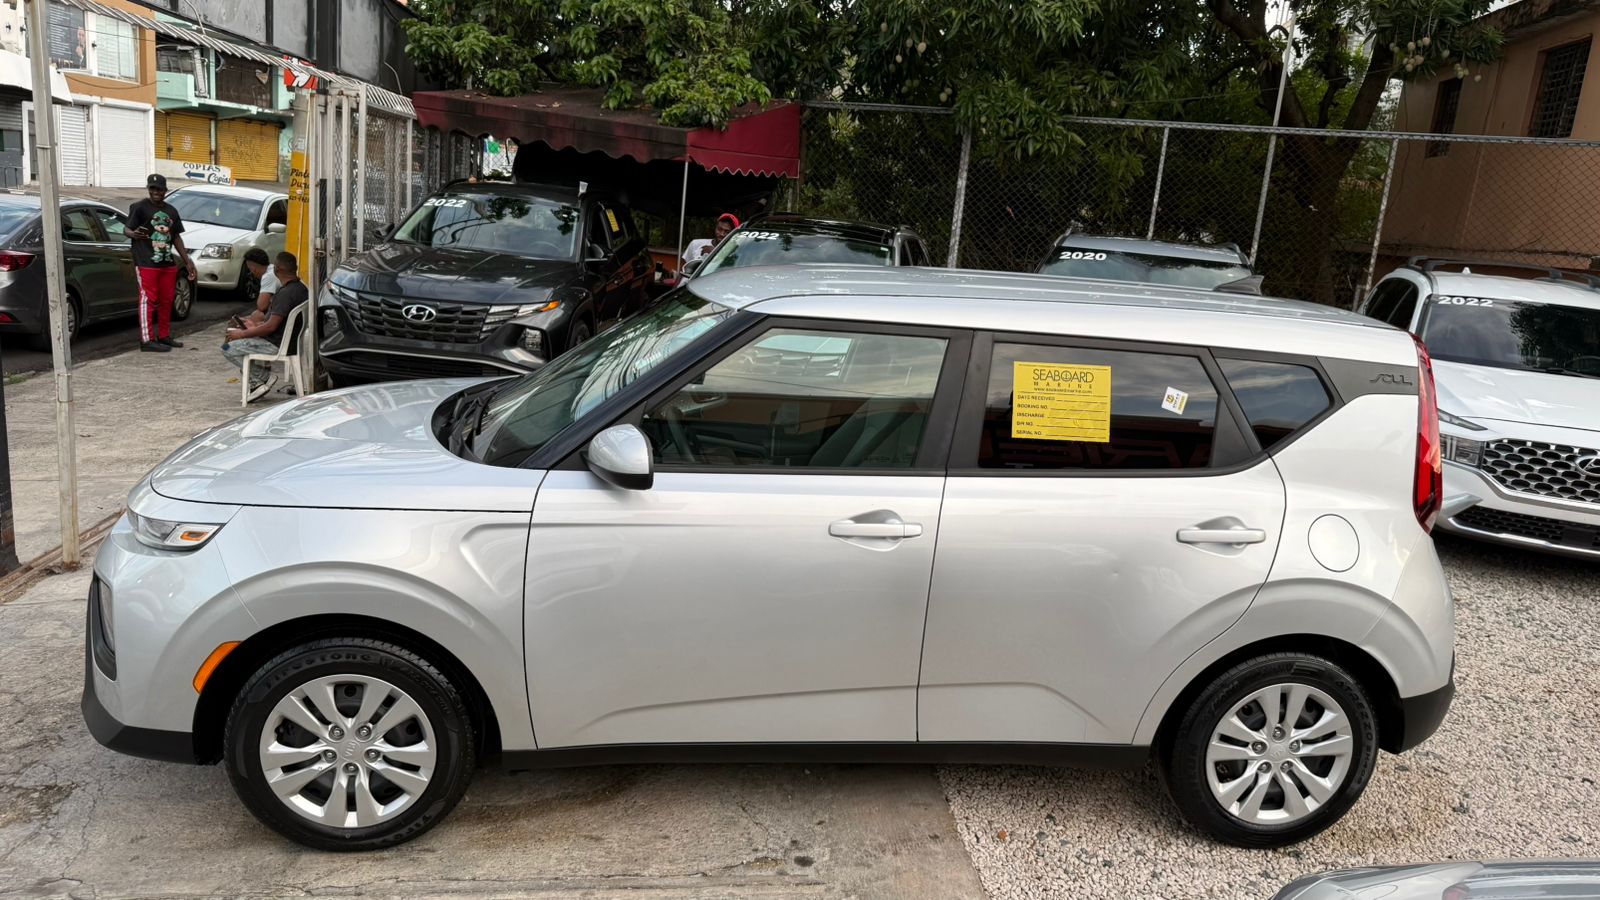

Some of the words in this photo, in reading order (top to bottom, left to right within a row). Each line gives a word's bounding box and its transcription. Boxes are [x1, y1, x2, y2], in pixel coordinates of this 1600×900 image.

[183, 162, 221, 172] COPIAS
[423, 198, 467, 208] 2022
[737, 231, 780, 240] 2022
[1059, 251, 1107, 261] 2020
[1438, 295, 1494, 308] 2022
[1033, 368, 1094, 383] SEABOARD
